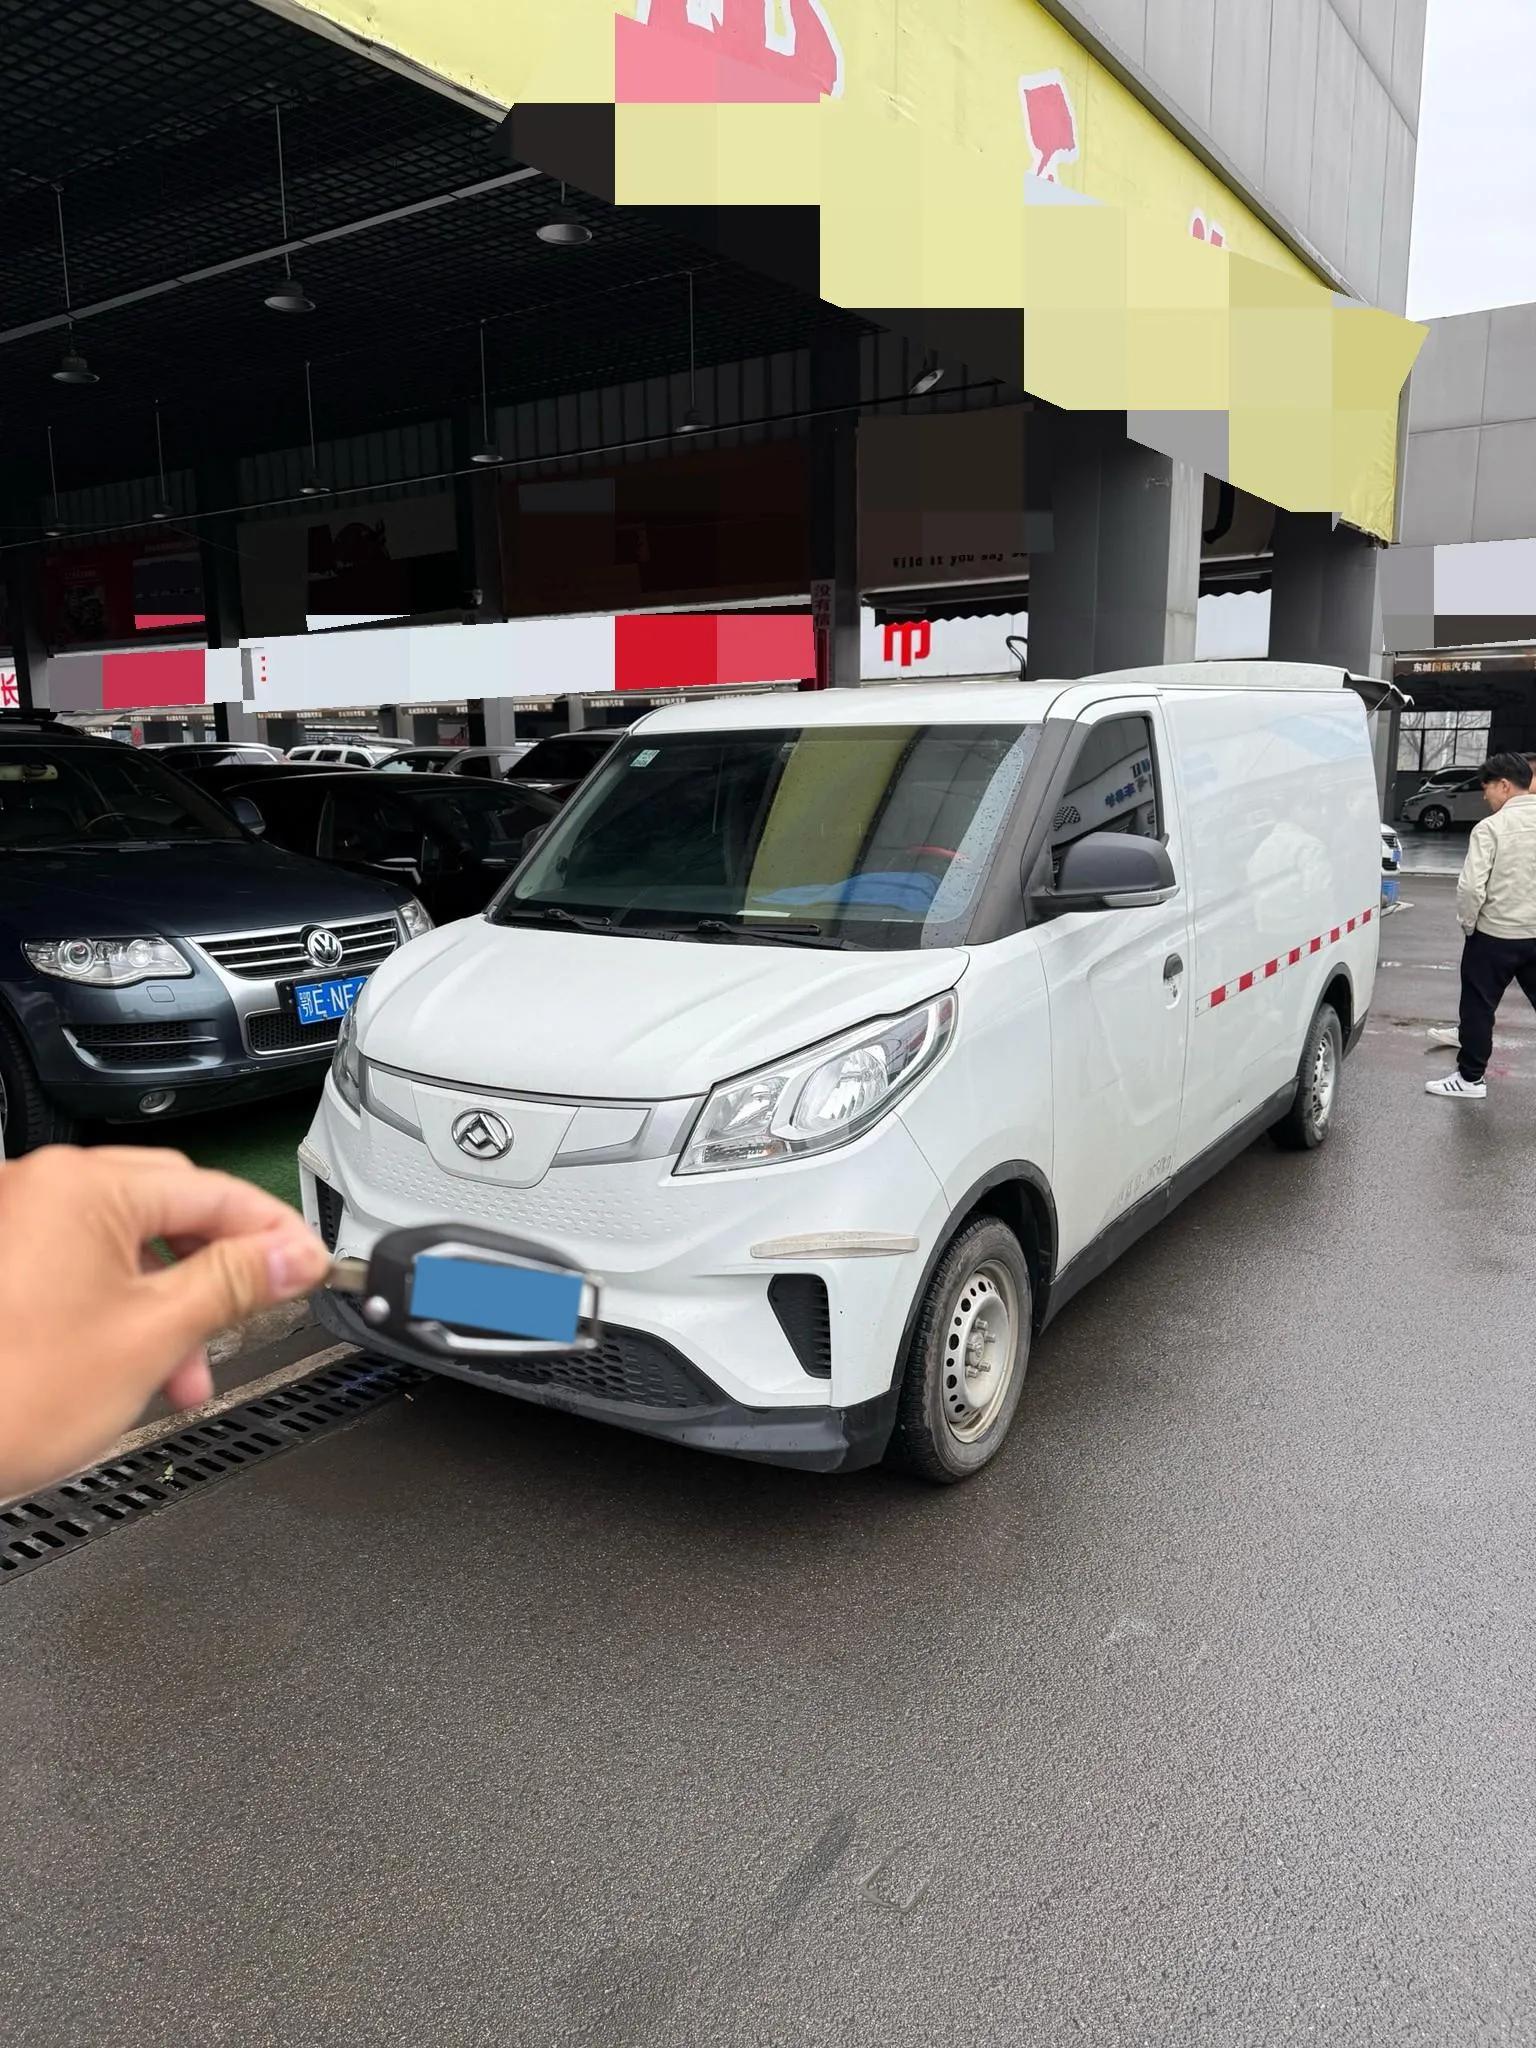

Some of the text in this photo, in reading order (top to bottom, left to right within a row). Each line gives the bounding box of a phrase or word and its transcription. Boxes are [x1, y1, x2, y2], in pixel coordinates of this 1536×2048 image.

[950, 554, 974, 566] you
[1413, 661, 1482, 673] 东城国际汽车城
